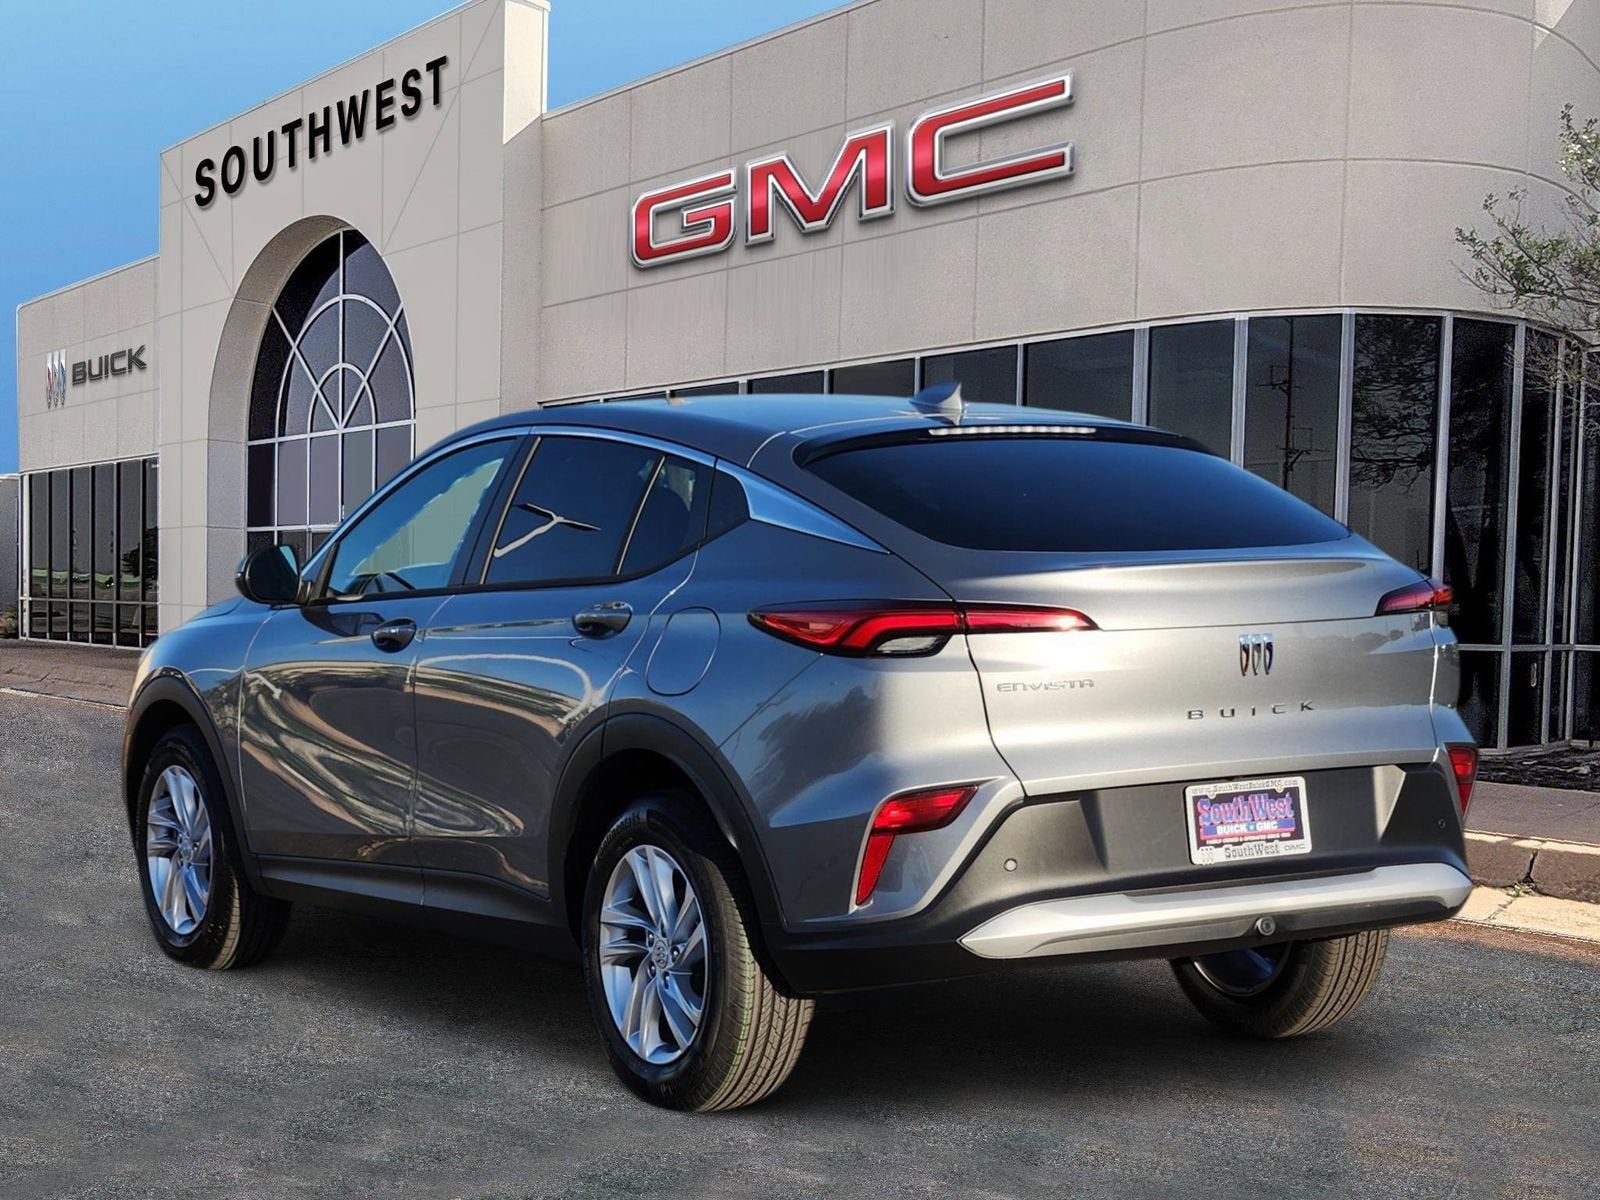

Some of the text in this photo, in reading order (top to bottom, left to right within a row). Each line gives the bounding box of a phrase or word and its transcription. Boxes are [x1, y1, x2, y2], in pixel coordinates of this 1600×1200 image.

[194, 55, 448, 208] SOUTHWEST
[630, 69, 1075, 269] GMC
[72, 344, 147, 386] BUICK
[997, 678, 1095, 692] ENVISTA
[1187, 700, 1315, 720] BUICK
[1197, 792, 1294, 825] SouthWest
[1216, 820, 1278, 835] BUICK GMC
[1224, 842, 1280, 859] SouthWest
